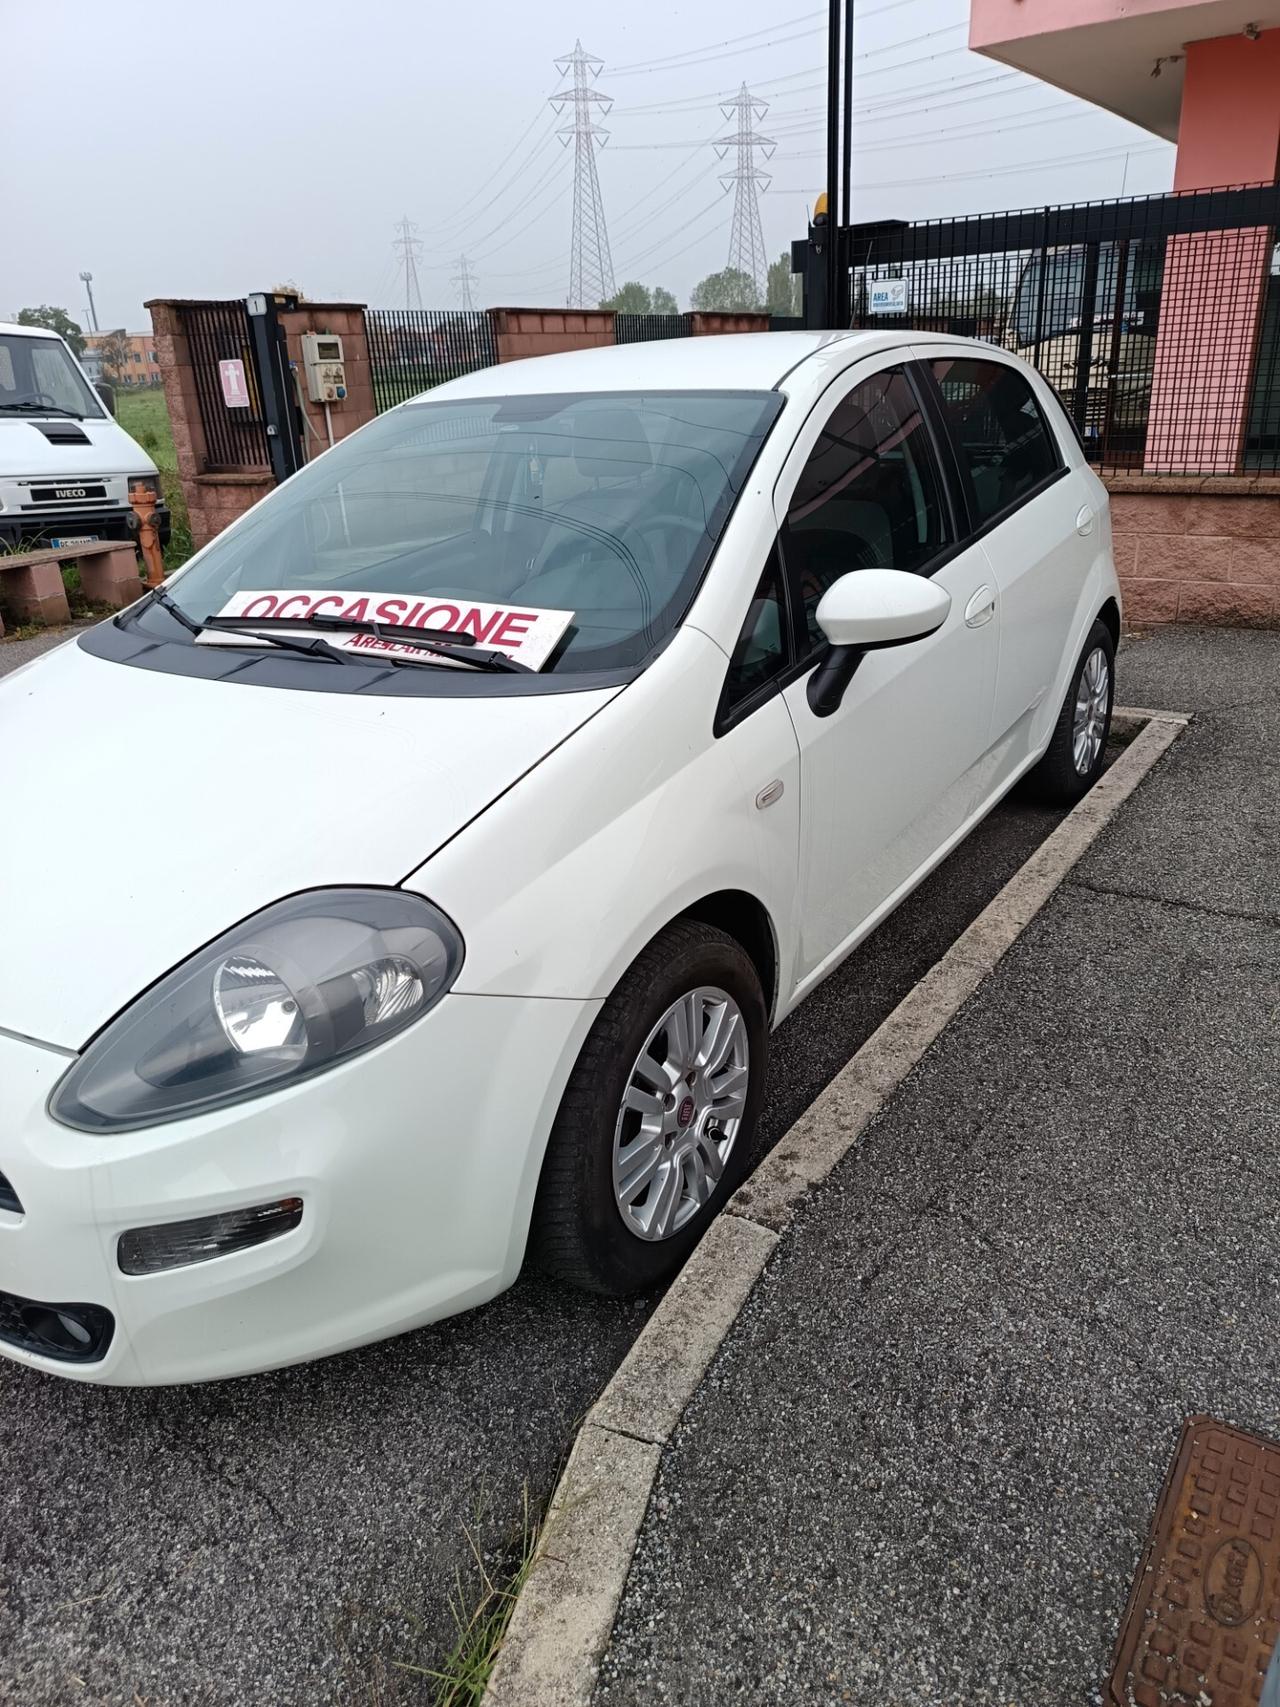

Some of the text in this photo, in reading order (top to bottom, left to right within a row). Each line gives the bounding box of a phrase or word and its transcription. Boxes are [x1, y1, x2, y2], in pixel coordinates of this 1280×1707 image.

[873, 292, 889, 301] AREA
[55, 488, 86, 498] IVECO
[240, 594, 539, 648] OCCASIONE
